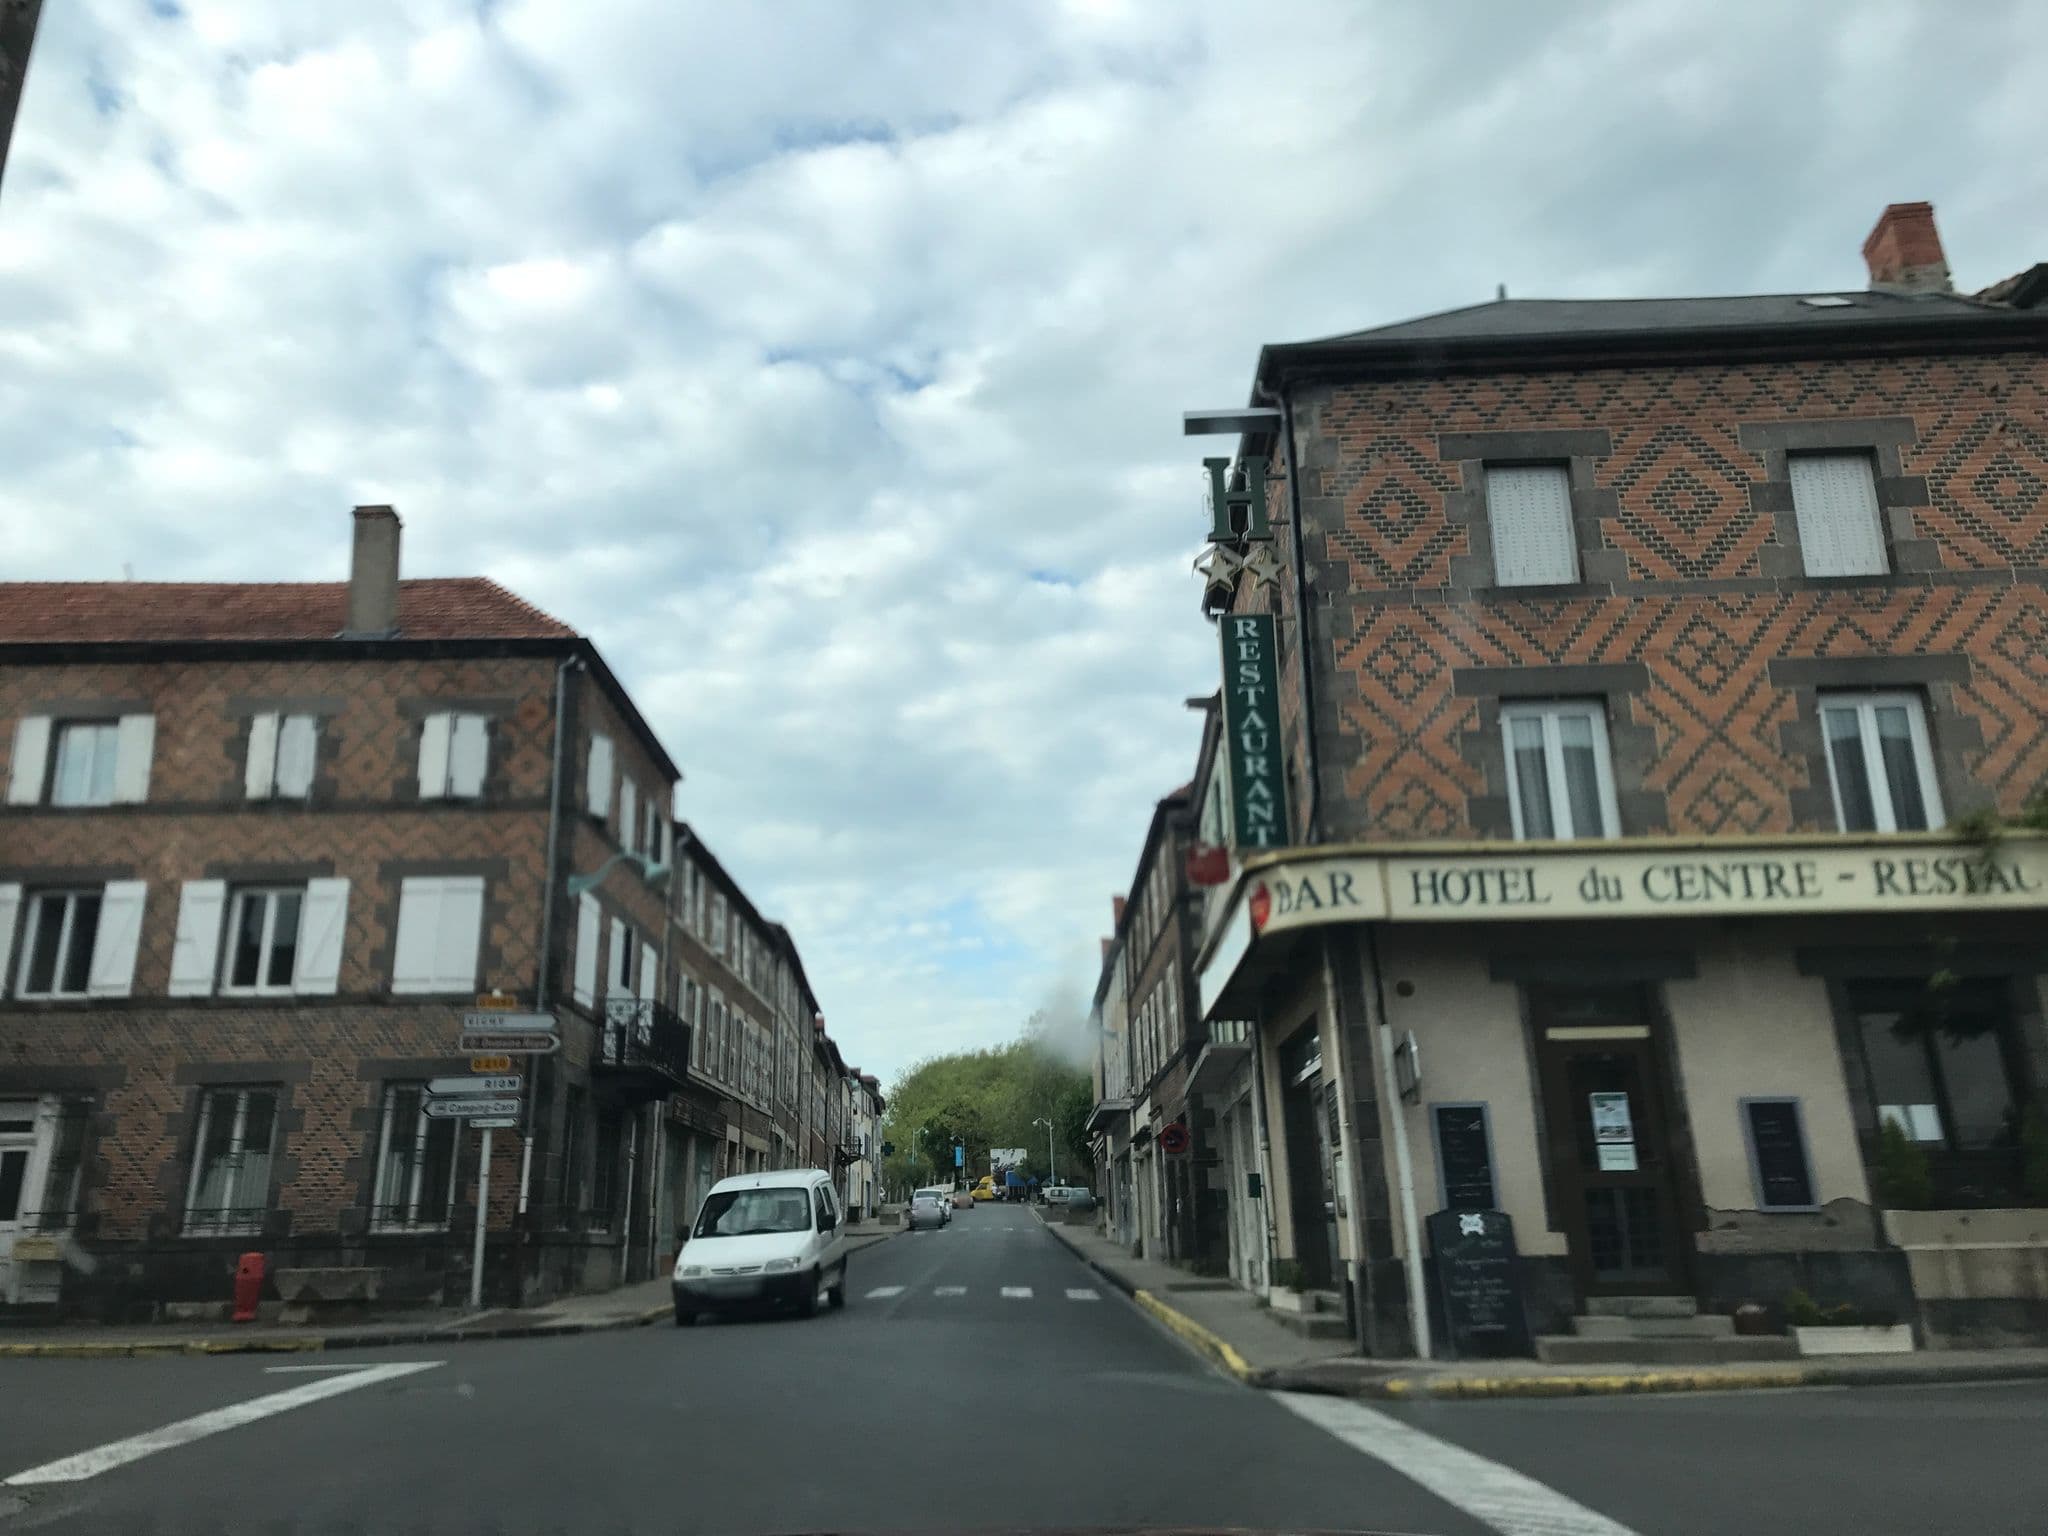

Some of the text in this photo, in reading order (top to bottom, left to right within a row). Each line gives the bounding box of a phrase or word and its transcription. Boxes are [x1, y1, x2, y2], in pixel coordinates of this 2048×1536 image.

[1203, 457, 1273, 542] H
[1234, 619, 1278, 847] RESTAURANT
[1274, 871, 1362, 914] BAR
[1409, 868, 1551, 904] HOTEL
[1579, 866, 1623, 902] du
[1641, 861, 1823, 901] CENTRE
[484, 1079, 517, 1089] RIOM
